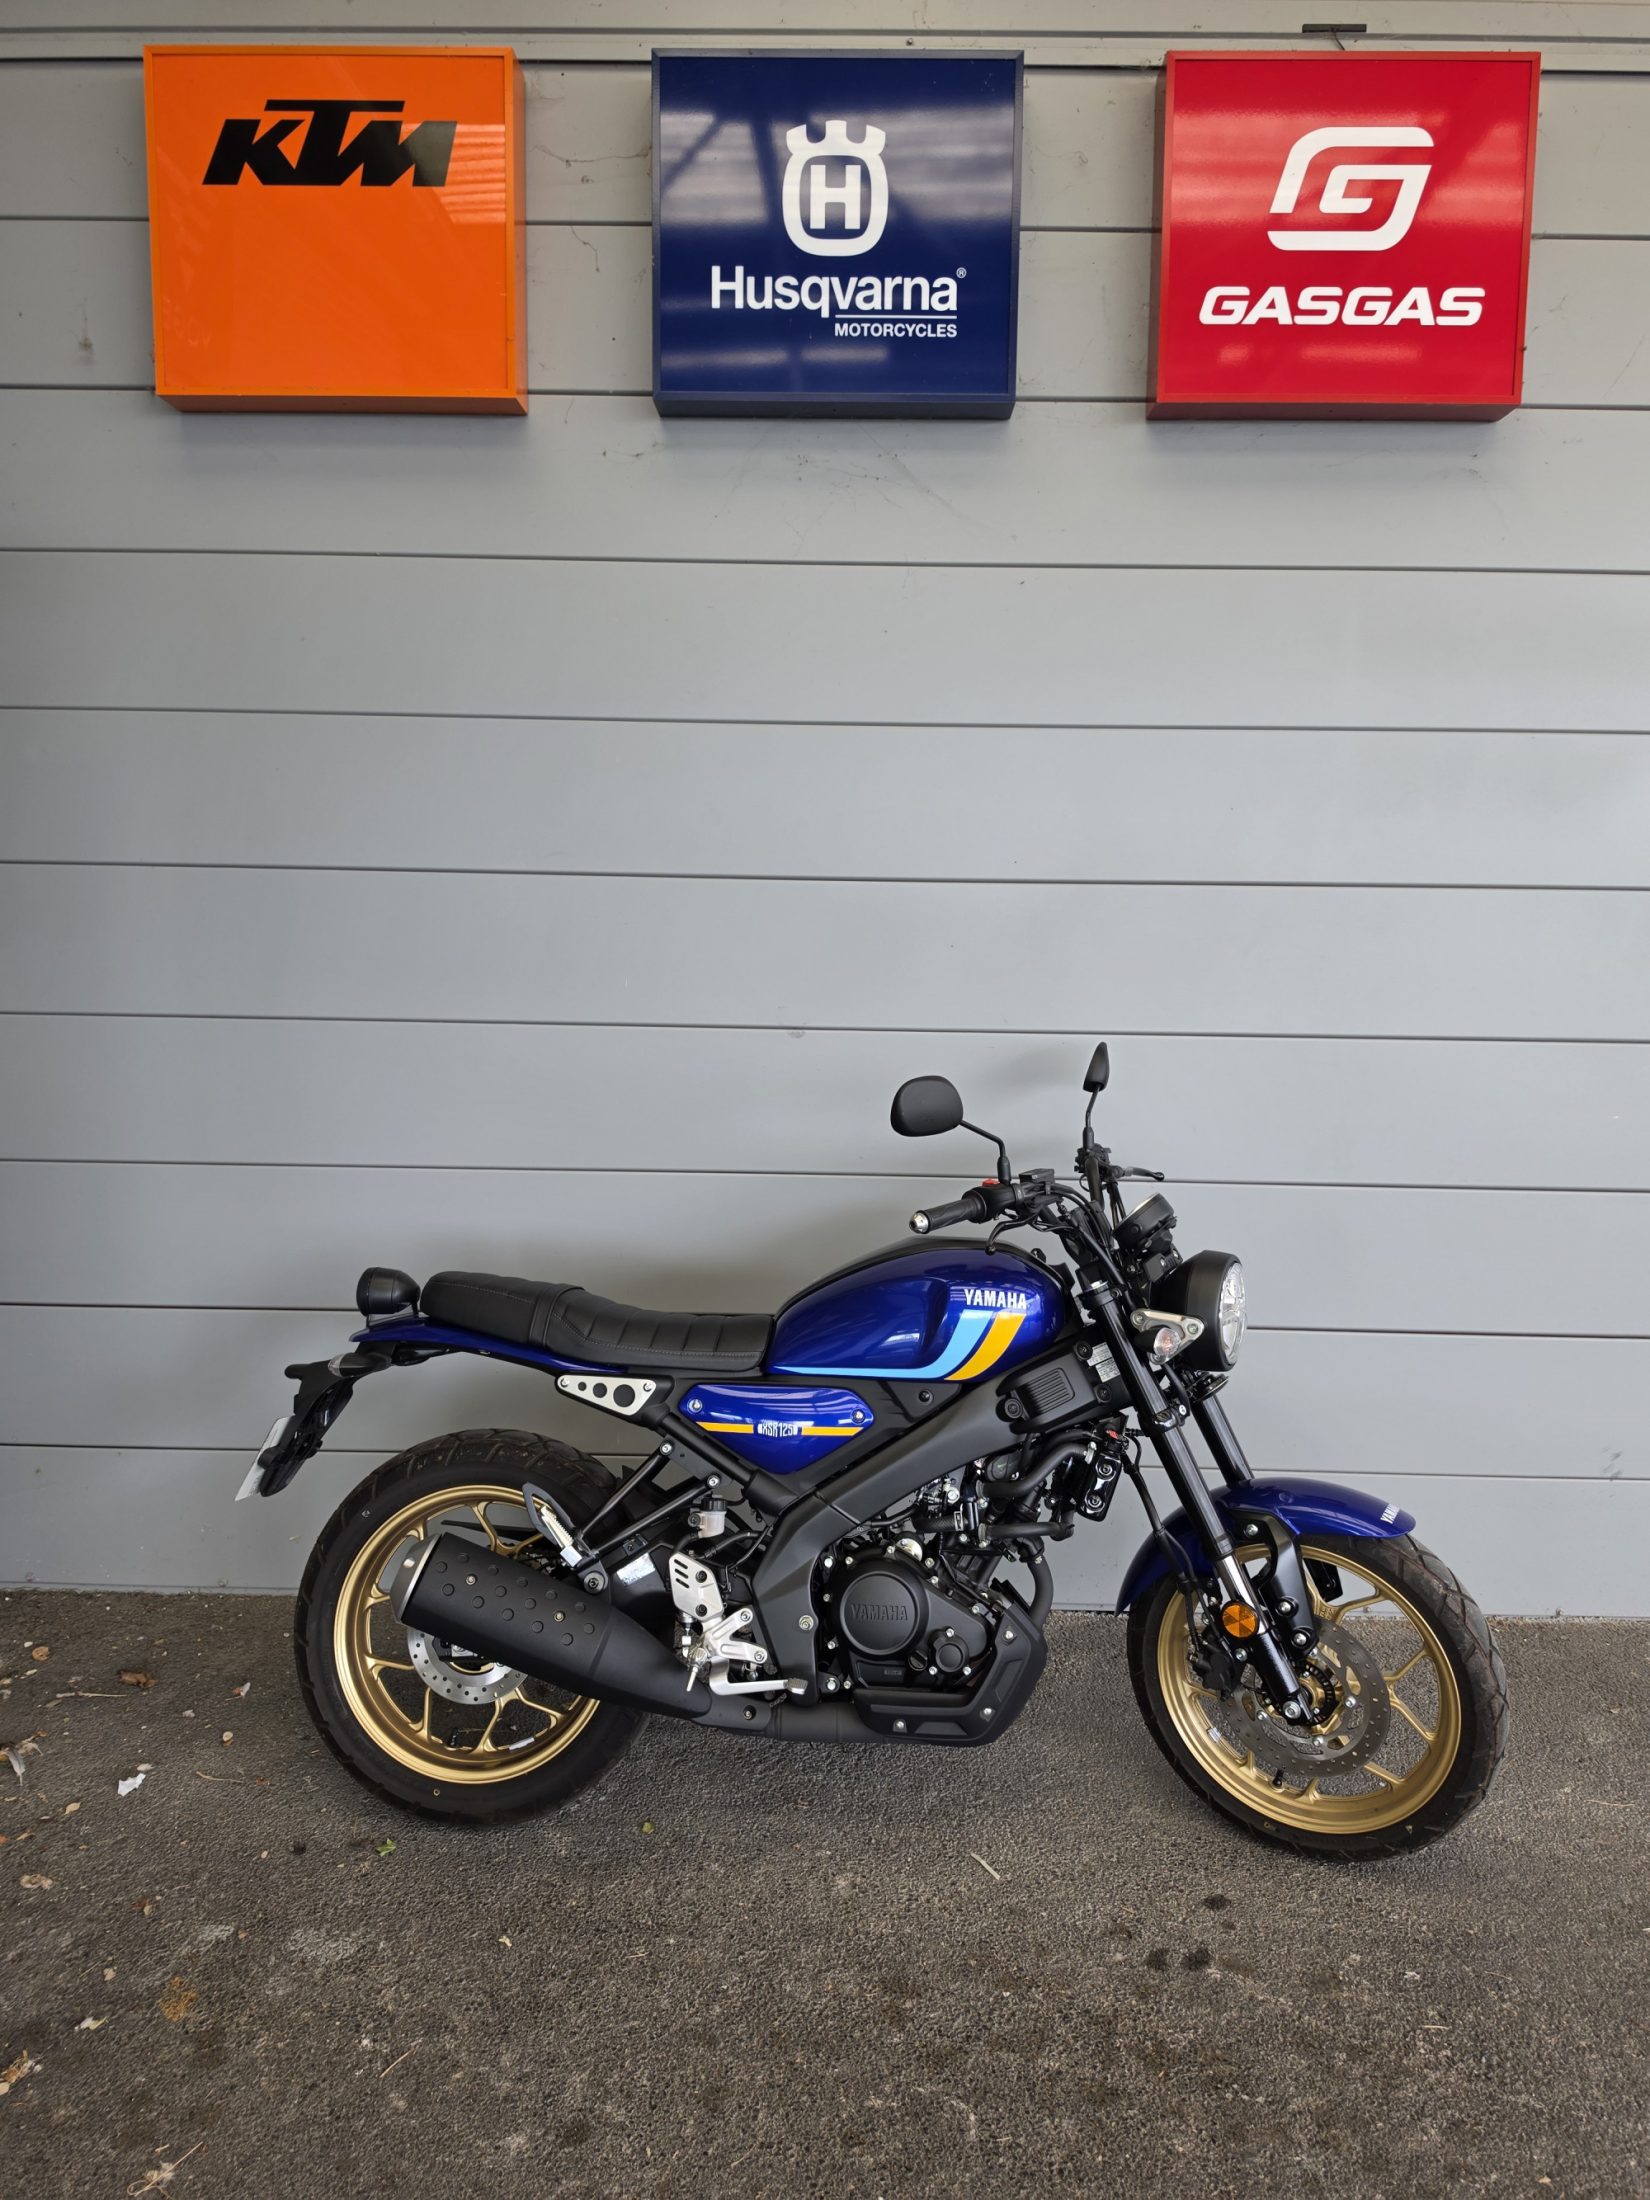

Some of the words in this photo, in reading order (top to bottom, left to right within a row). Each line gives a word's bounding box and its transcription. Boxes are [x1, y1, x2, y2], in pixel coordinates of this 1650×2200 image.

[203, 99, 457, 187] KTM
[1199, 286, 1486, 326] GASGAS
[834, 323, 958, 338] MOTORCYCLES
[964, 1288, 1027, 1310] YAMAHA
[762, 1421, 794, 1438] XSR125
[851, 1604, 909, 1621] YAMAHA
